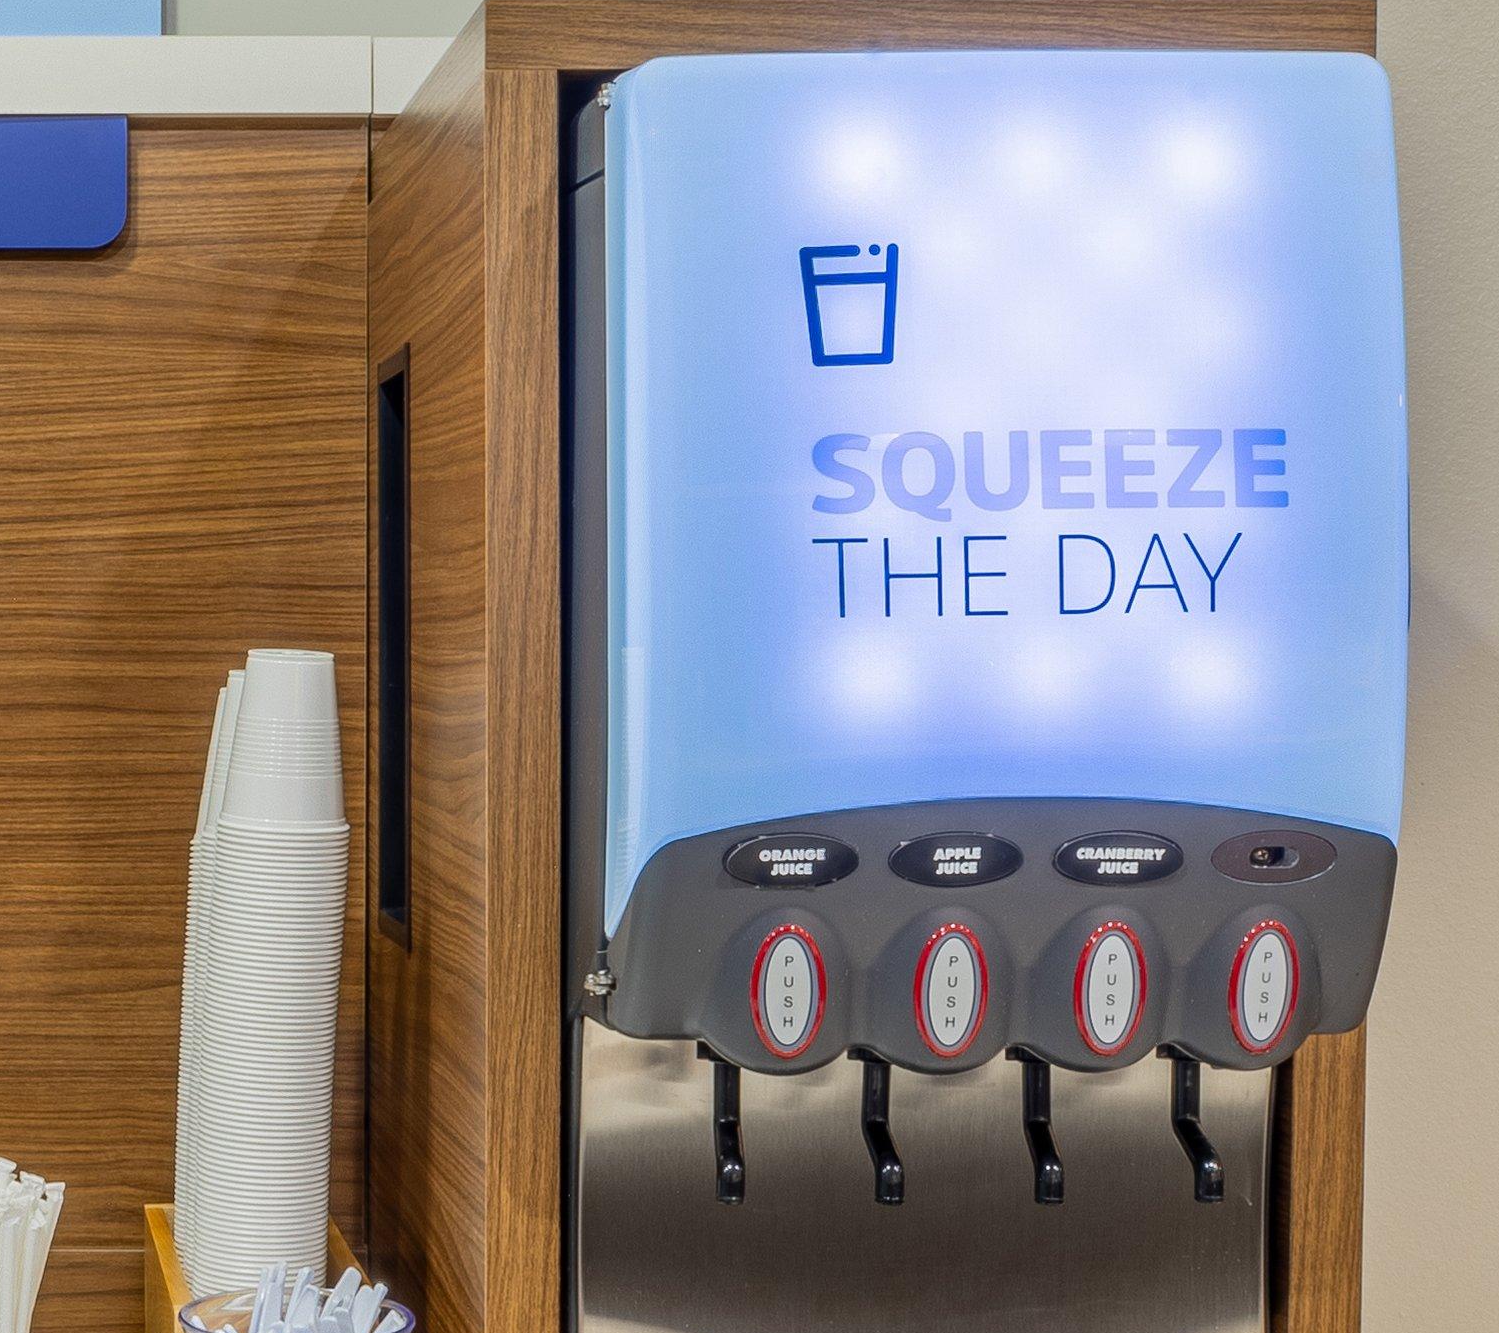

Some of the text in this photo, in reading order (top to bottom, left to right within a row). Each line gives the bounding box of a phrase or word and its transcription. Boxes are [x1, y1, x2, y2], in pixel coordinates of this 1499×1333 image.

[810, 428, 1290, 523] SQUEEZE
[811, 532, 1243, 619] THE DAY
[758, 847, 827, 862] ORANGE
[770, 862, 814, 876] JUICE
[932, 846, 982, 861] APPLE
[936, 861, 979, 875] JUICE
[1076, 847, 1166, 861] CRANBERRY
[1097, 861, 1139, 874] JUICE
[782, 955, 795, 1028] PUSH
[945, 955, 959, 1028] PUSH
[1104, 953, 1118, 1026] PUSH
[1258, 951, 1273, 1023] PUSH
